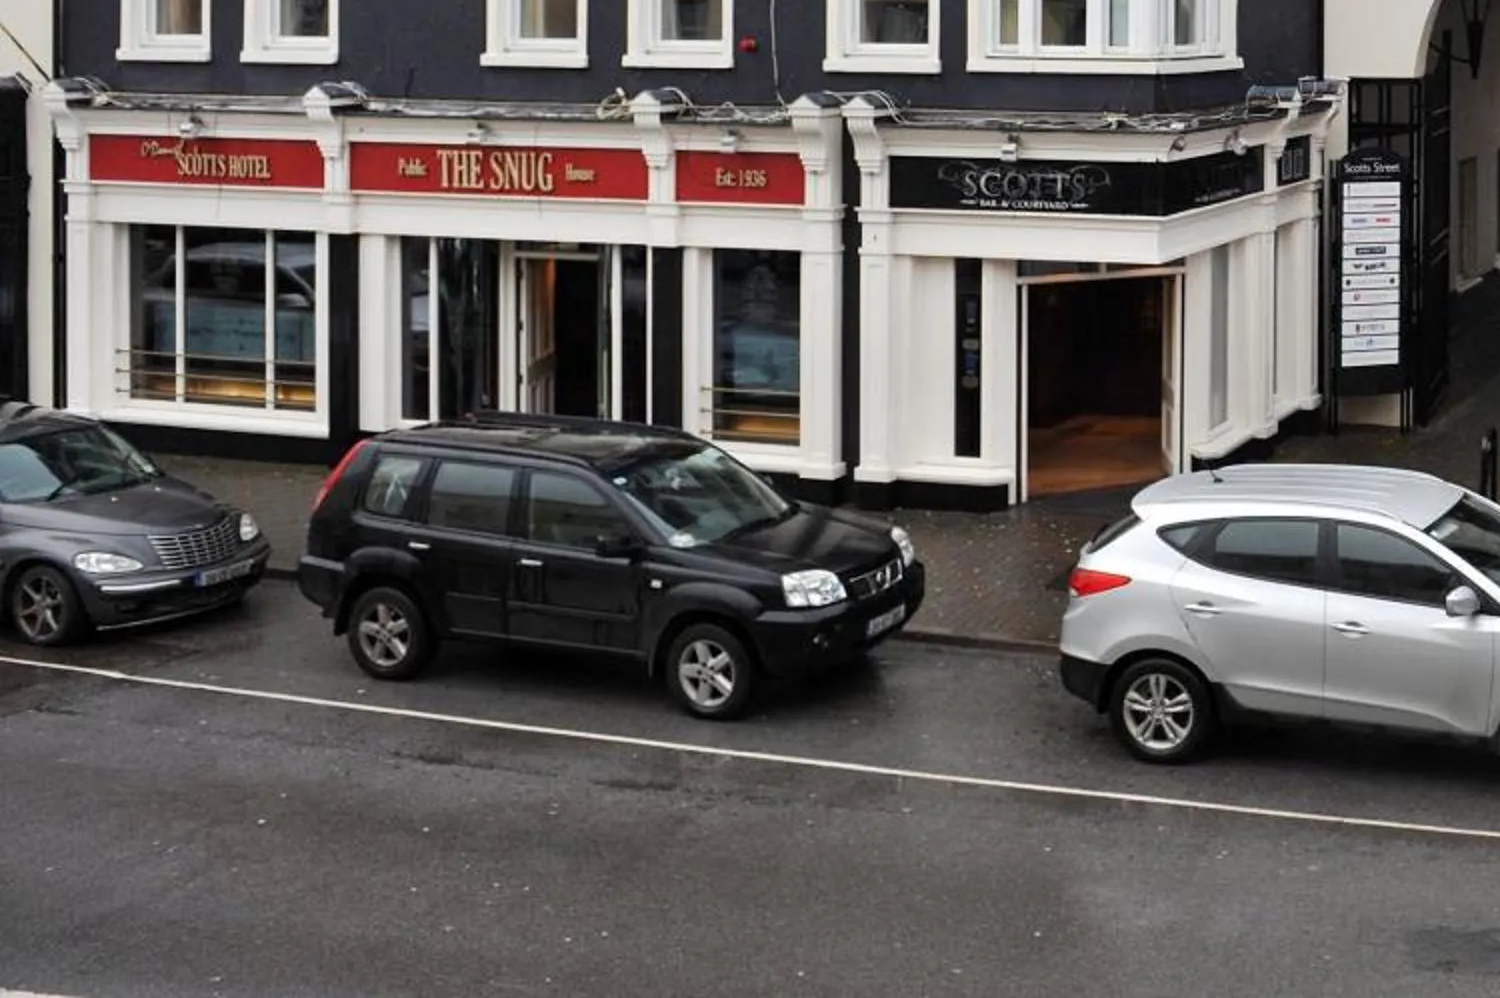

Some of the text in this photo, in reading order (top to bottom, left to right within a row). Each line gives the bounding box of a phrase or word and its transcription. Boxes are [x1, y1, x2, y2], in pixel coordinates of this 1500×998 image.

[229, 155, 271, 179] HOTEL
[436, 149, 553, 192] THE SNUG
[1343, 161, 1401, 173] Scotts Street
[963, 169, 1086, 201] SCOTTS
